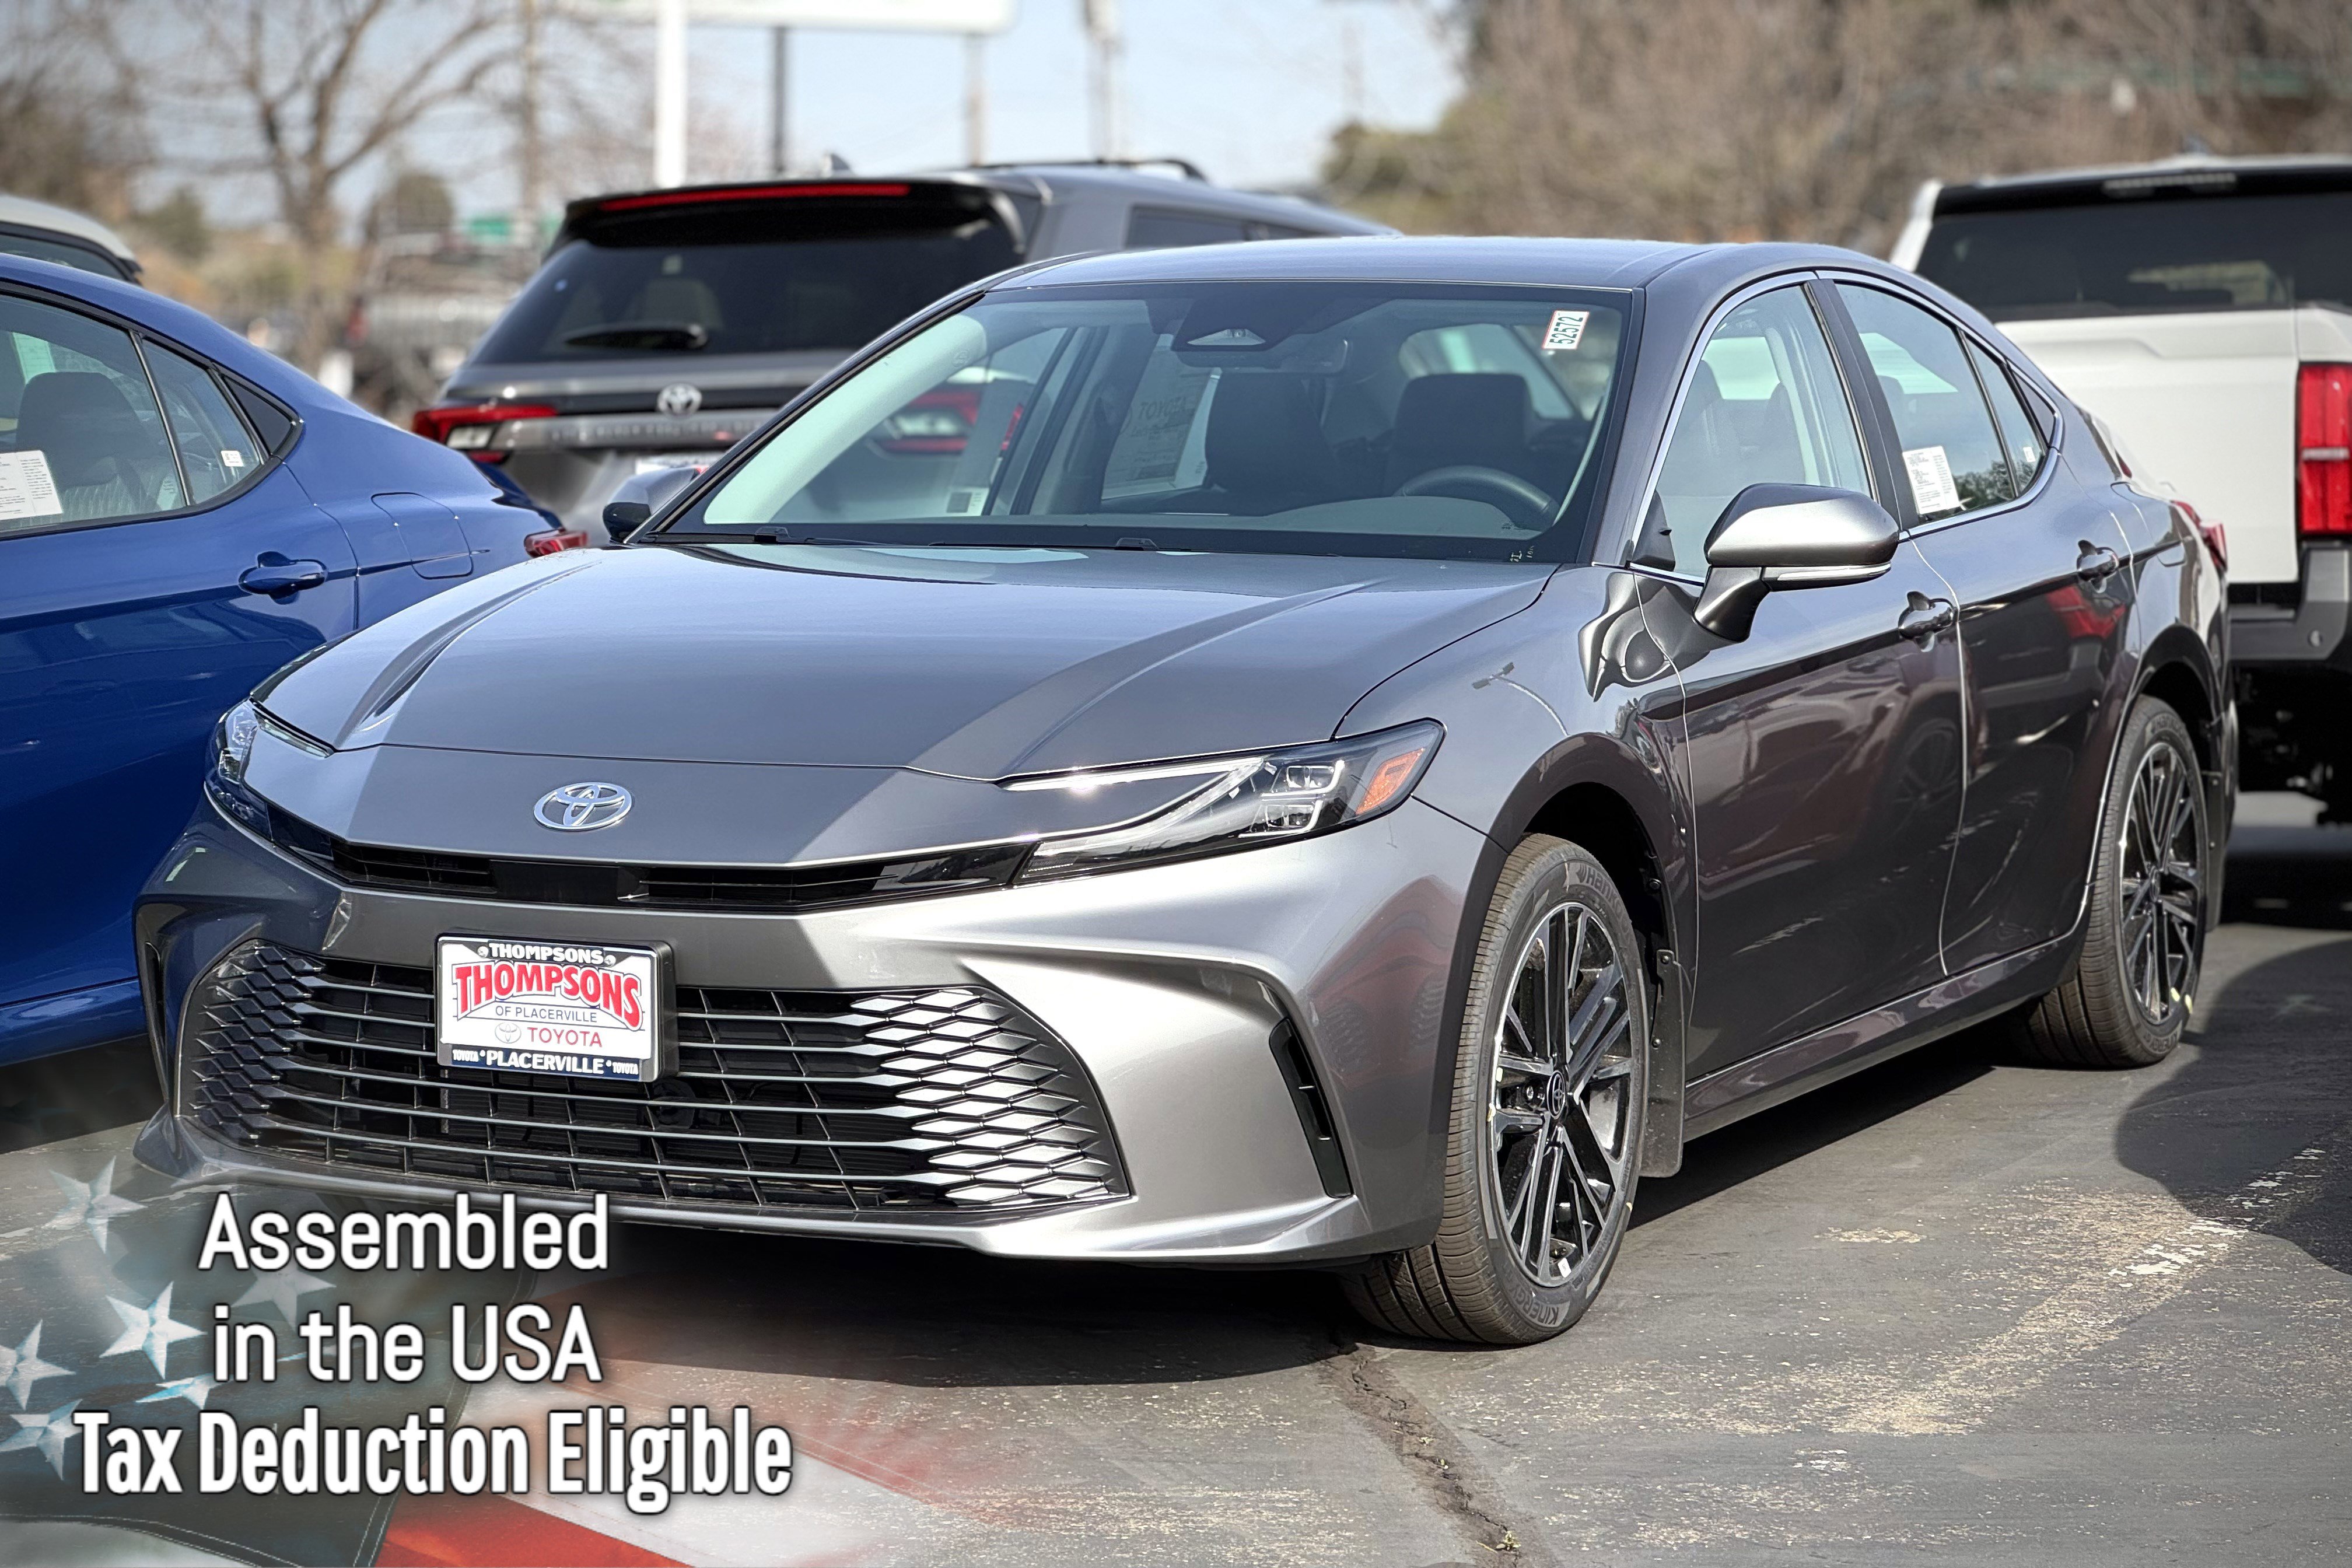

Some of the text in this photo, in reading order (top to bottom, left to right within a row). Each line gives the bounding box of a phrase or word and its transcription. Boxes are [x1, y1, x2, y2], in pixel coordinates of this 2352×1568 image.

[1549, 316, 1584, 344] 52572
[488, 942, 604, 965] THOMPSONS
[454, 963, 640, 1028] THOMPSONS
[495, 1005, 597, 1023] OF PLACERVILLE
[526, 1027, 603, 1048] TOYOTA
[452, 1049, 639, 1075] TOYOTA PLACERVILLE TOYOTA
